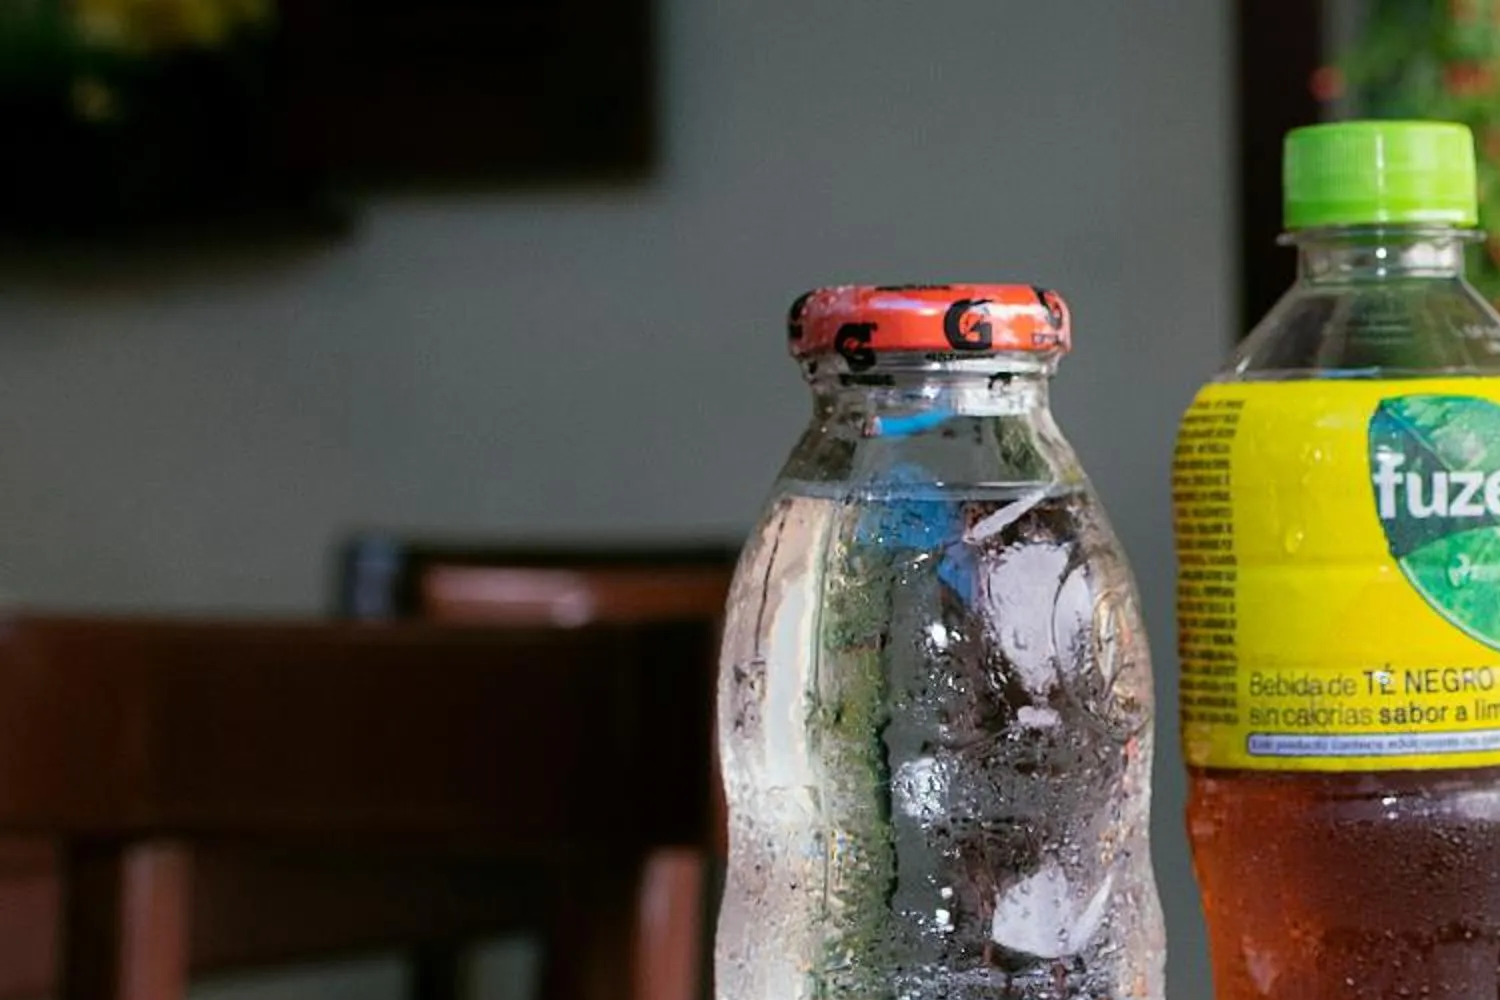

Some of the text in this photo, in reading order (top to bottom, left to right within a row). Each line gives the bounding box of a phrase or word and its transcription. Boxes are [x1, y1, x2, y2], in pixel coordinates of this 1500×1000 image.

[1249, 671, 1322, 696] Bebida
[1327, 674, 1356, 695] de
[1404, 666, 1495, 694] NEGRO
[1249, 705, 1280, 727] sin
[1379, 702, 1446, 725] sabor
[1454, 707, 1468, 722] a
